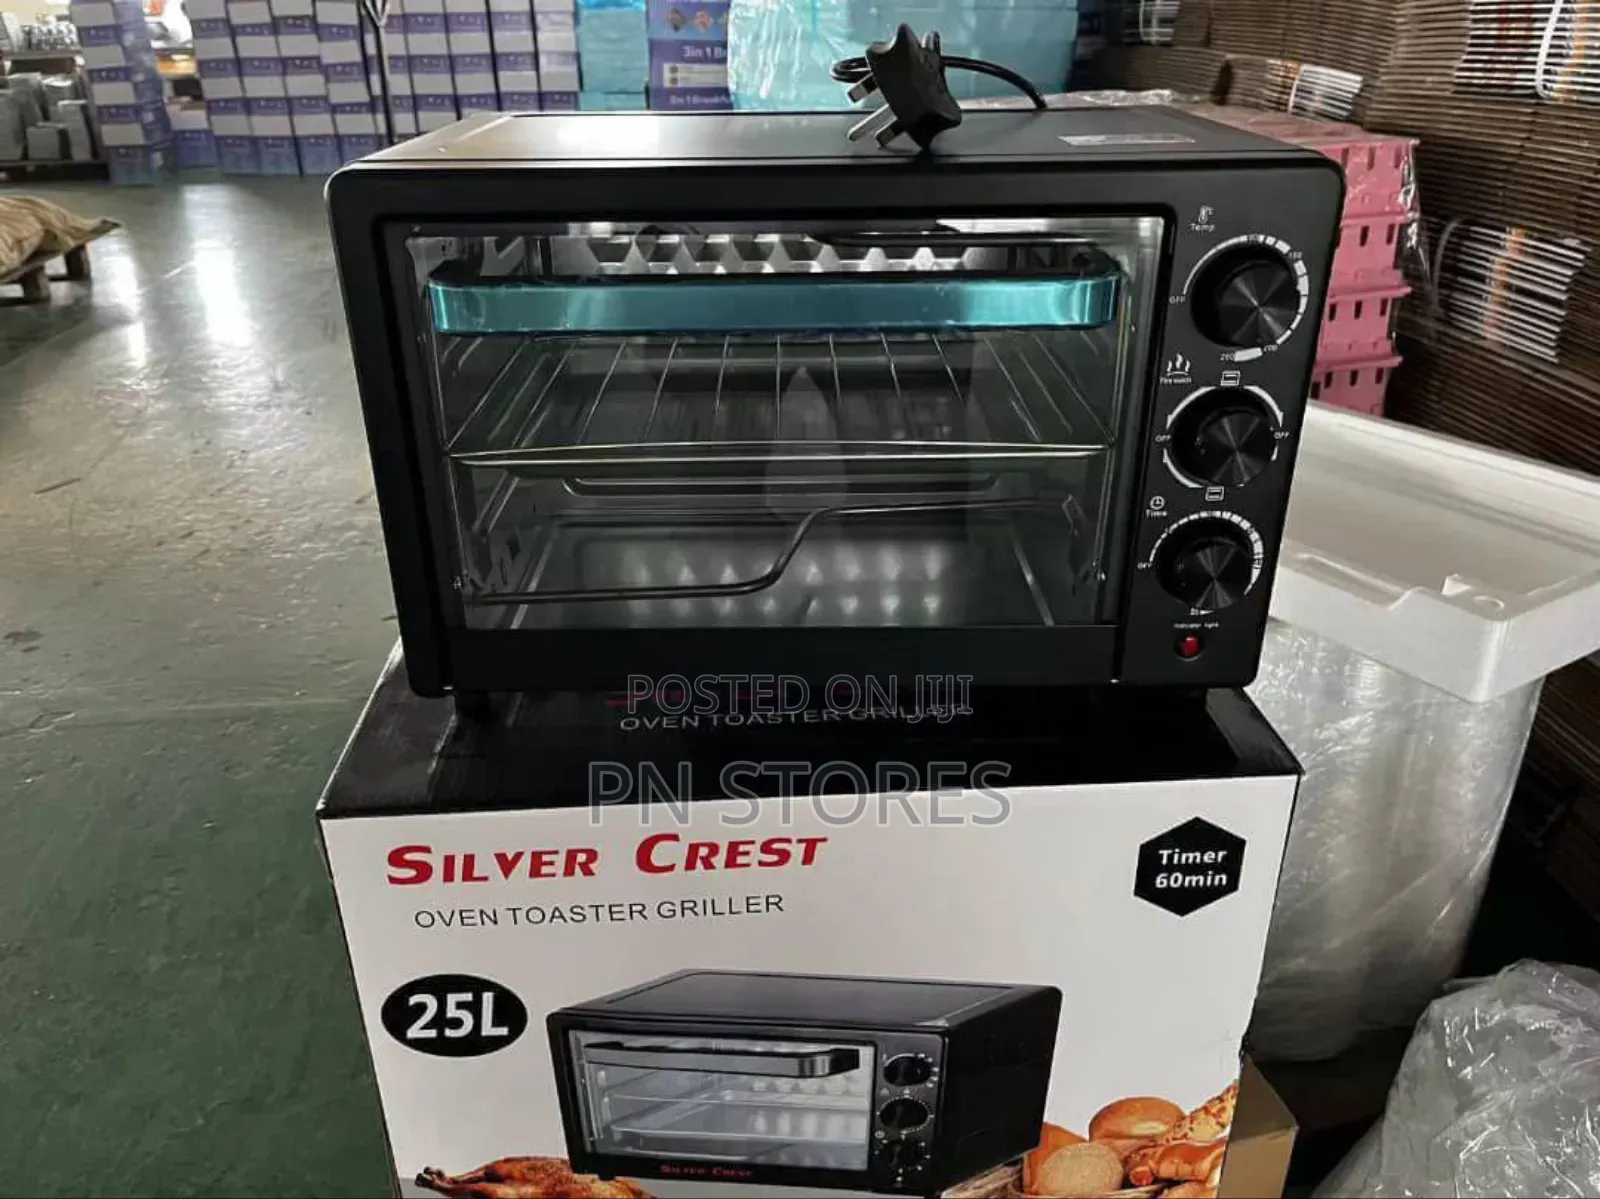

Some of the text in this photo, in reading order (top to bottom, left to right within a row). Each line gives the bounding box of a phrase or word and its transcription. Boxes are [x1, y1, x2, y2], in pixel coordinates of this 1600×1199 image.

[1190, 223, 1216, 233] Temp
[1169, 296, 1186, 305] OFF
[1155, 435, 1171, 443] OFF
[1274, 431, 1290, 440] OFF
[620, 716, 700, 732] OVEN
[712, 709, 841, 728] TOASTER
[386, 832, 829, 886] SILVER CREST
[1158, 848, 1228, 866] Timer
[1154, 870, 1228, 889] 60min
[414, 894, 785, 930] OVEN TOASTER GRILLER
[405, 991, 511, 1040] 25L
